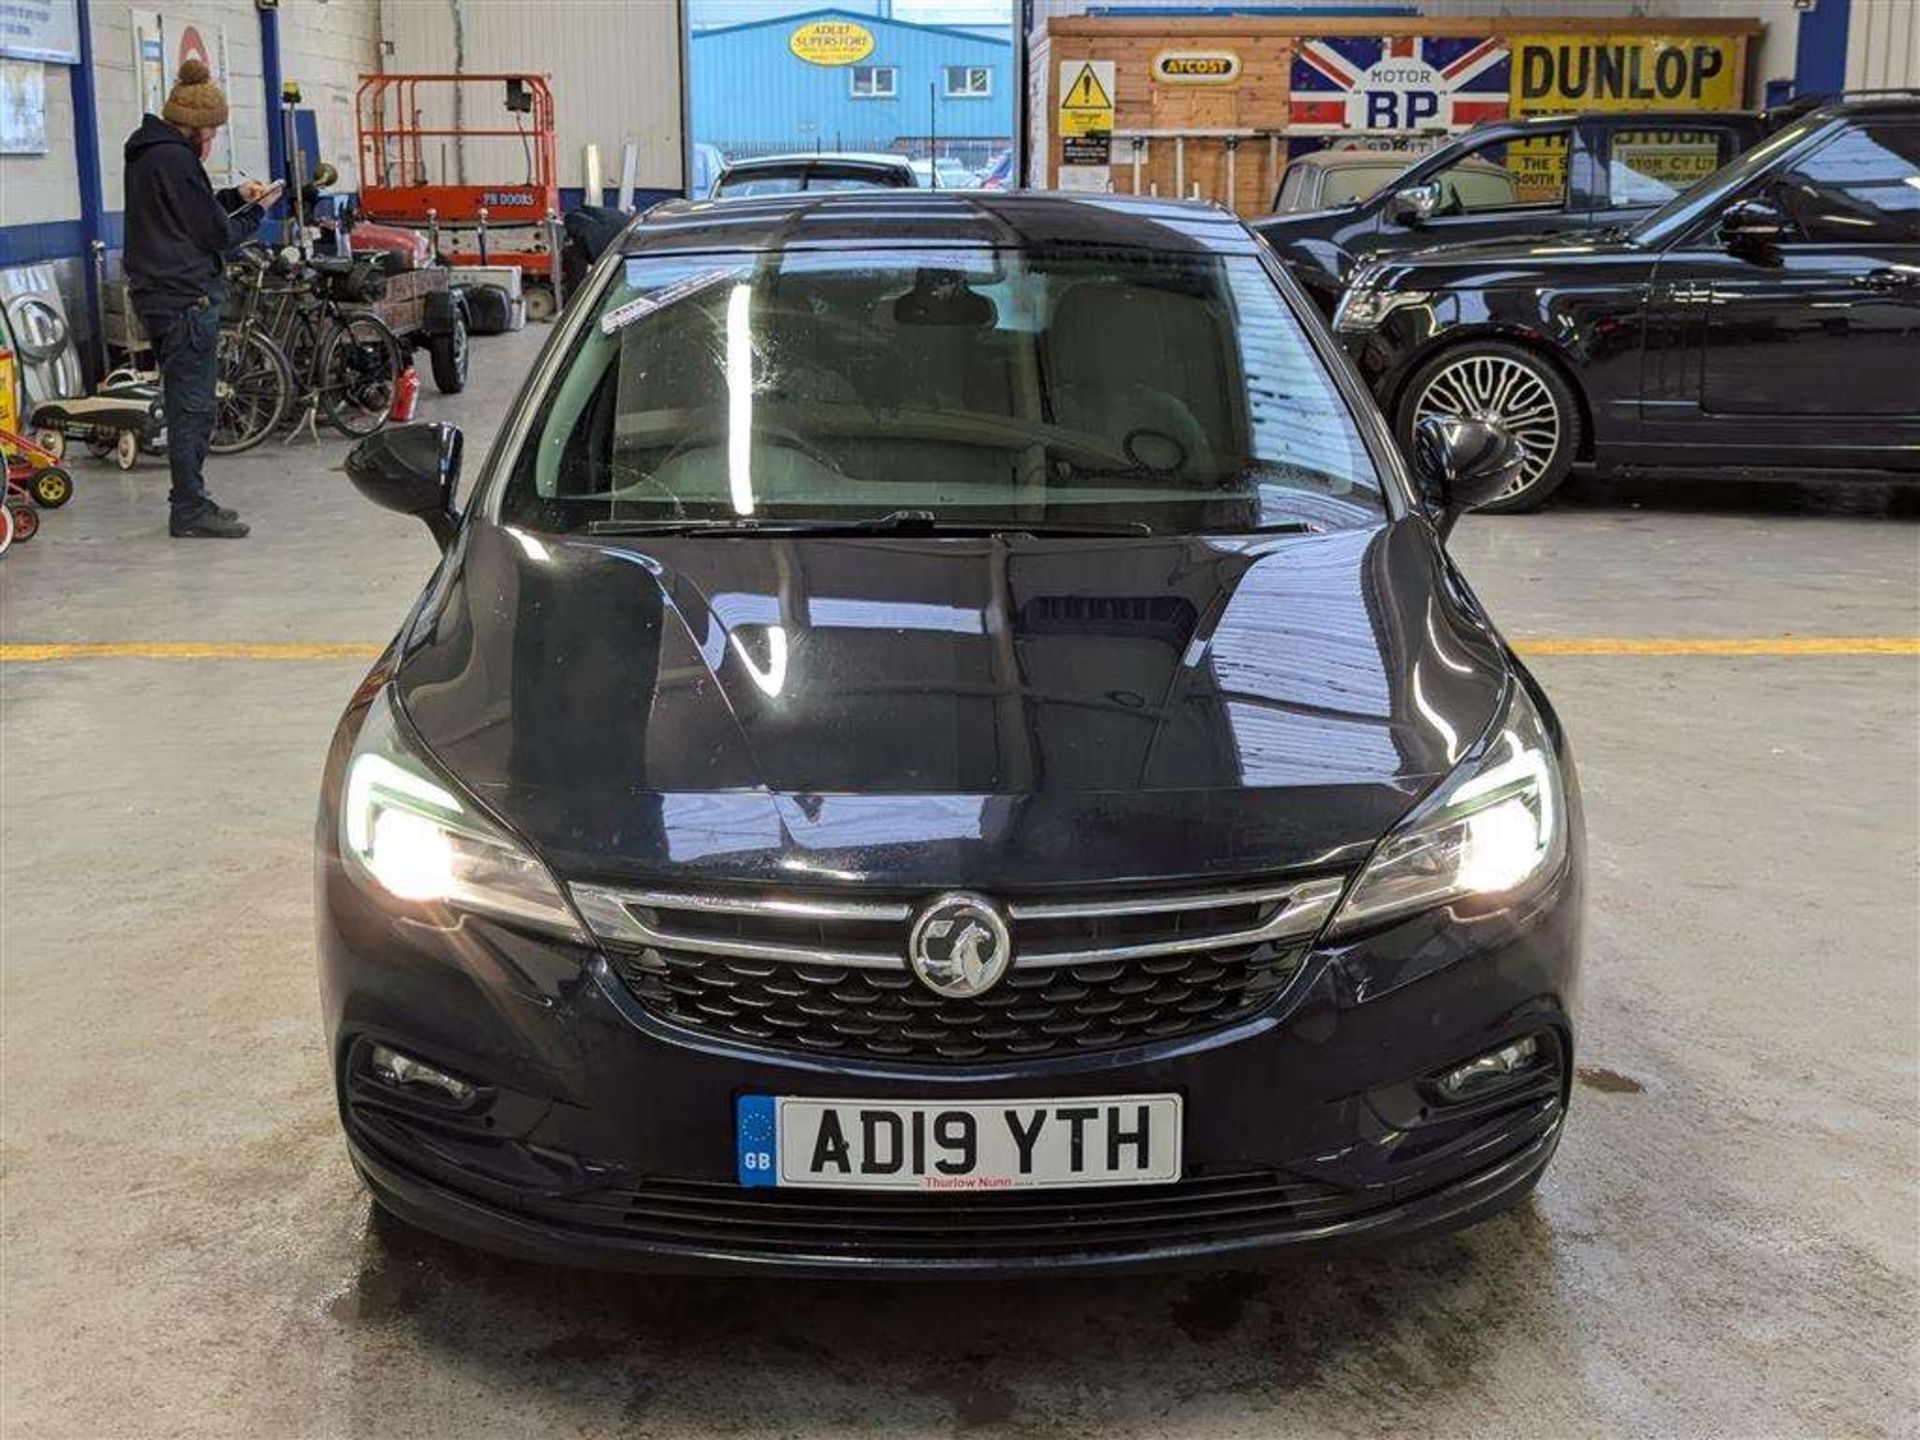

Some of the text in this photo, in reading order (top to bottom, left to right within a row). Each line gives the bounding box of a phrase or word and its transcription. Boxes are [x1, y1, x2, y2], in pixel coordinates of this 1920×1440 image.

[1167, 60, 1228, 73] ATCOST
[1522, 46, 1723, 99] DUNLOP
[1371, 69, 1431, 83] MOTOR
[1524, 157, 1550, 170] THE
[810, 1106, 1150, 1175] AD19 YTH
[744, 1152, 772, 1171] GB
[924, 1177, 975, 1189] Thurlow
[978, 1177, 1012, 1189] Nunn
